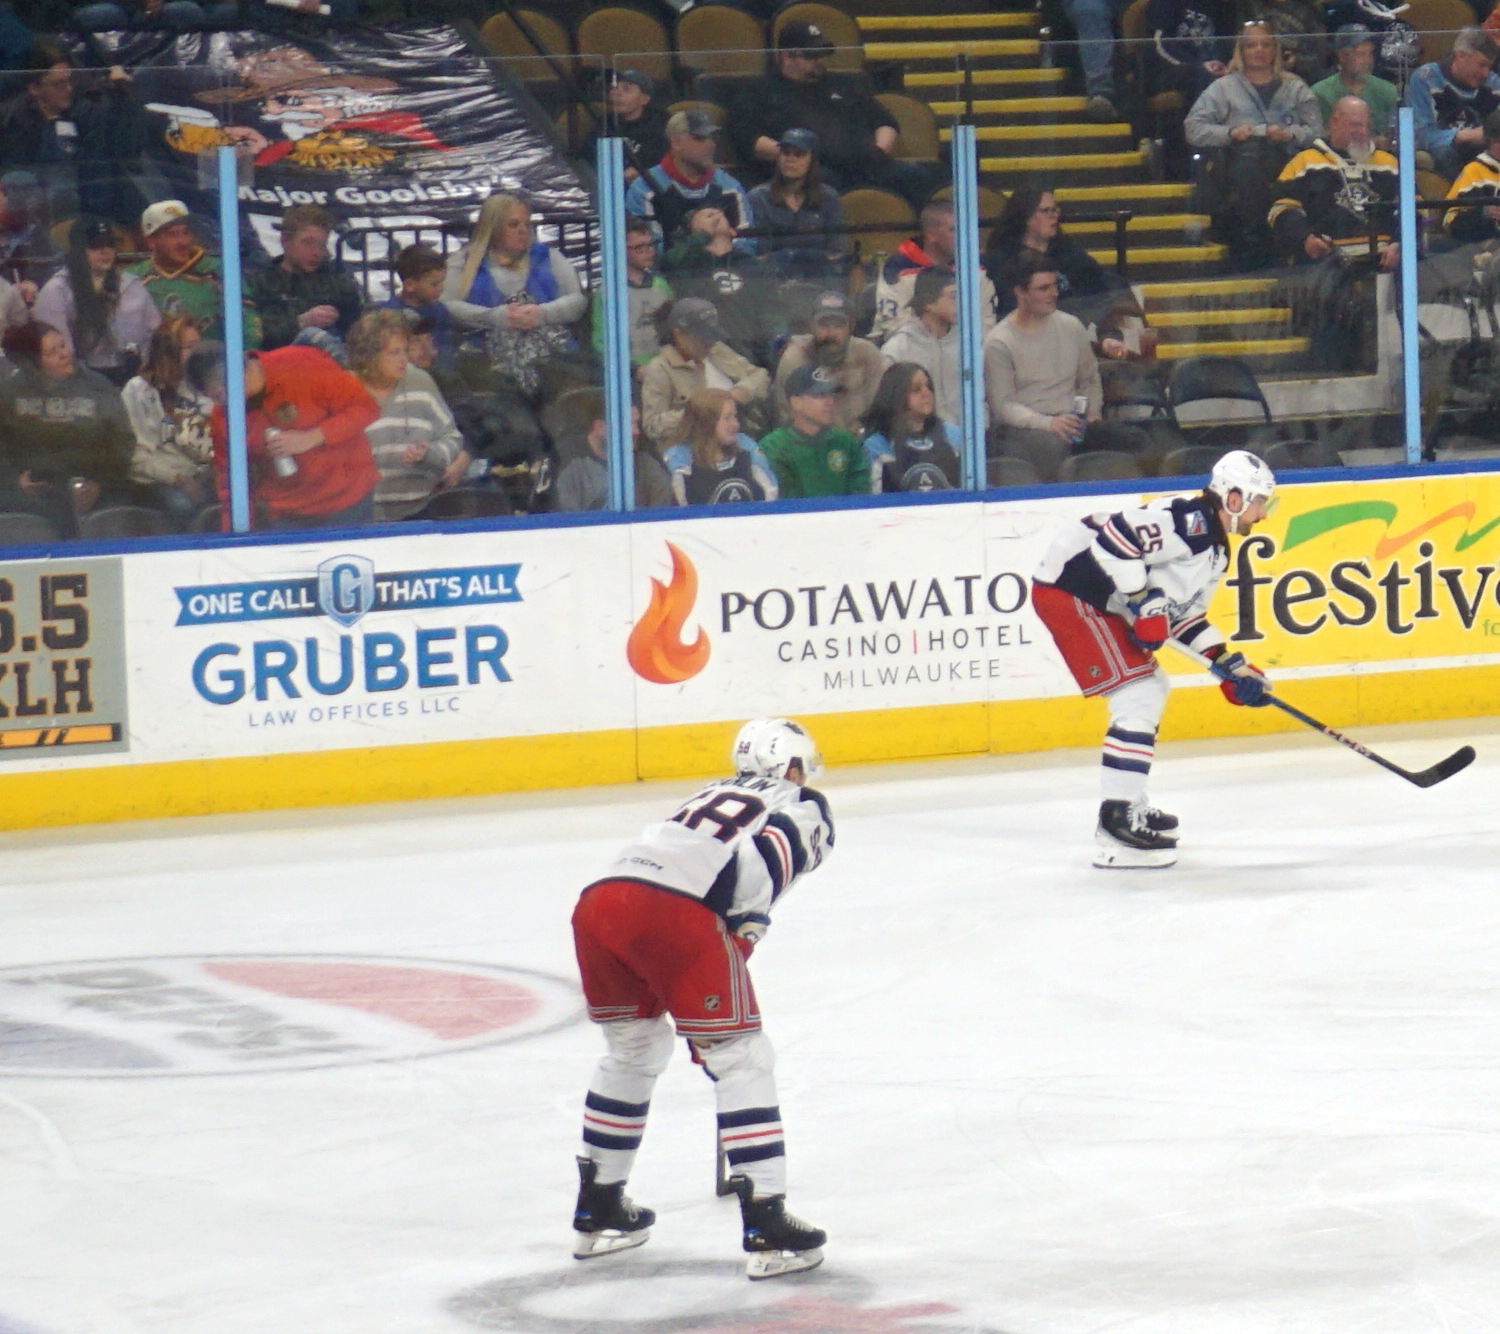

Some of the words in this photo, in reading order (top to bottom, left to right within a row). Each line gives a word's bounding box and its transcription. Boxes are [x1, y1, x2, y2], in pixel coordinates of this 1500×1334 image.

[336, 175, 523, 207] Goolsby's
[1135, 523, 1163, 554] 25
[189, 593, 245, 617] ONE
[249, 587, 316, 612] CALL
[376, 577, 463, 605] THAT'S
[466, 571, 514, 597] ALL
[331, 562, 362, 616] G
[721, 572, 1029, 633] POTAWATO
[192, 623, 515, 706] GRUBER
[778, 632, 902, 664] CASINO
[928, 624, 1033, 653] HOTEL
[823, 657, 1002, 690] MILWAUKEE
[248, 708, 297, 728] LAW
[309, 699, 409, 724] OFFICES
[420, 695, 462, 715] LLC
[672, 791, 765, 845] 8
